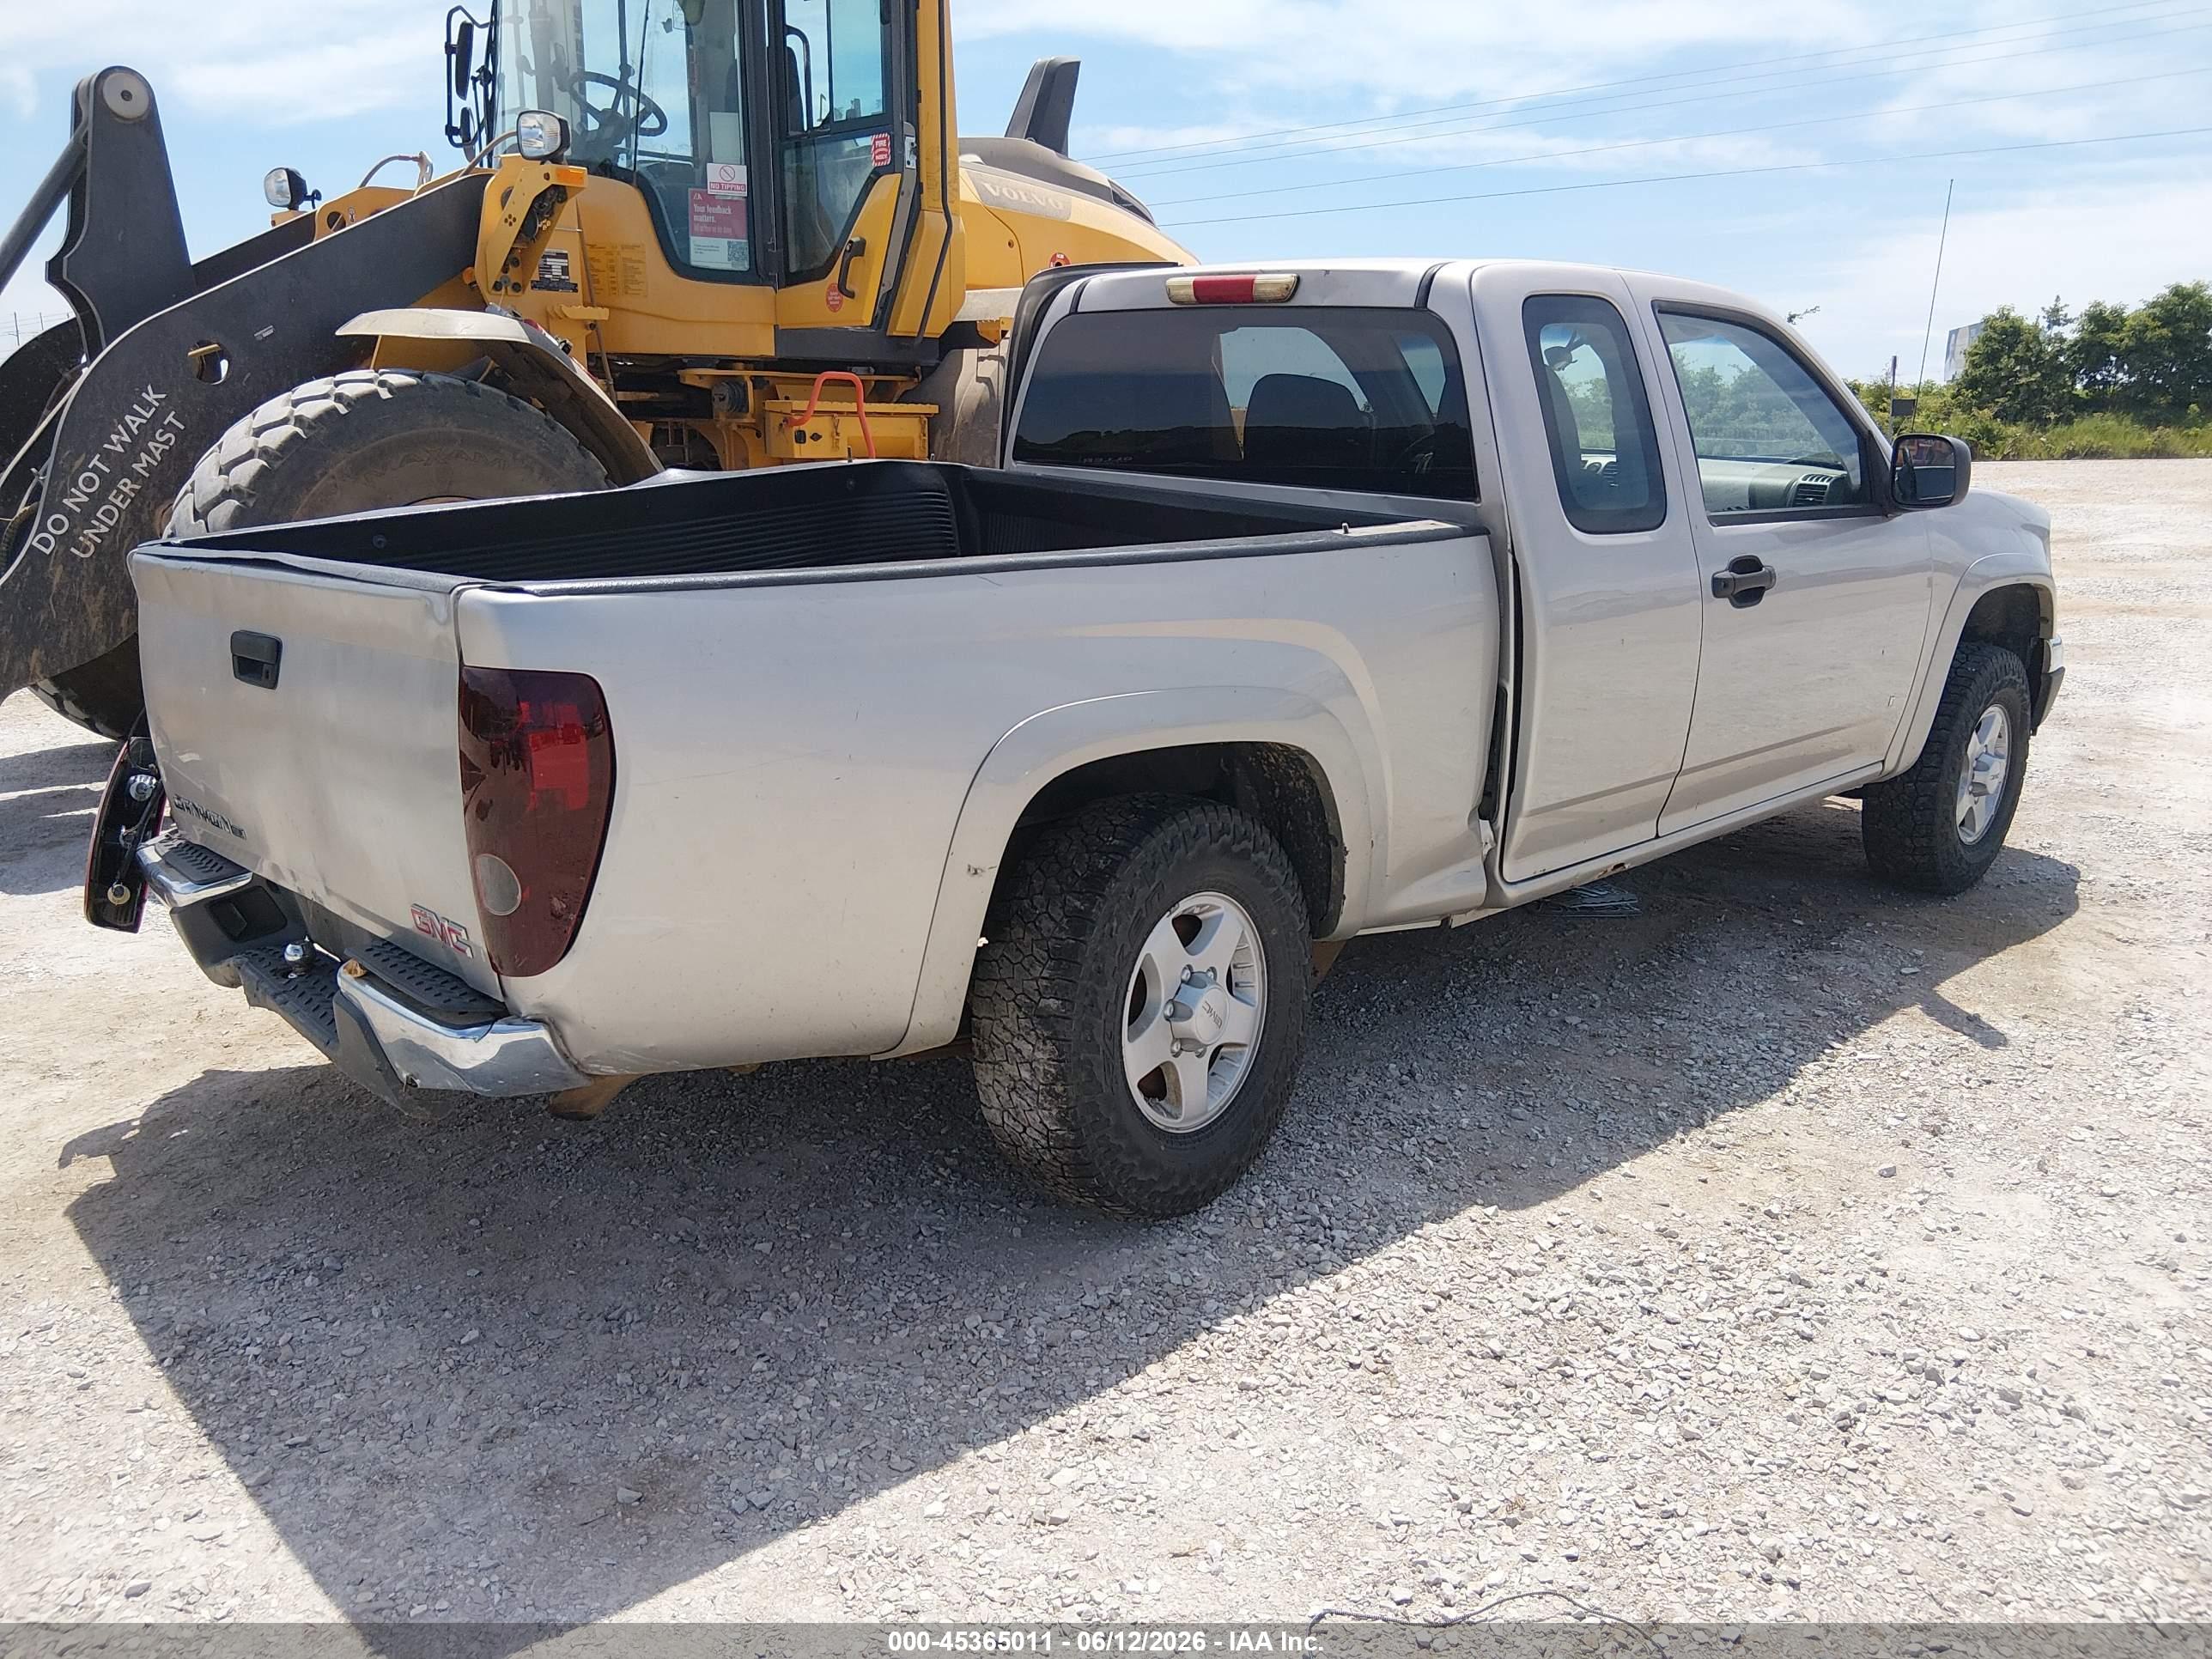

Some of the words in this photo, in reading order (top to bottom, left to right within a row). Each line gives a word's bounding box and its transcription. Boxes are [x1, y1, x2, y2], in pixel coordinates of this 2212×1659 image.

[983, 183, 1065, 210] VOLVO
[32, 514, 70, 556] DO
[62, 453, 111, 514] NOT
[103, 384, 167, 453] WALK
[70, 477, 143, 558] UNDER
[131, 410, 185, 478] MAST
[410, 902, 474, 959] GMC
[1202, 1000, 1224, 1030] GMC
